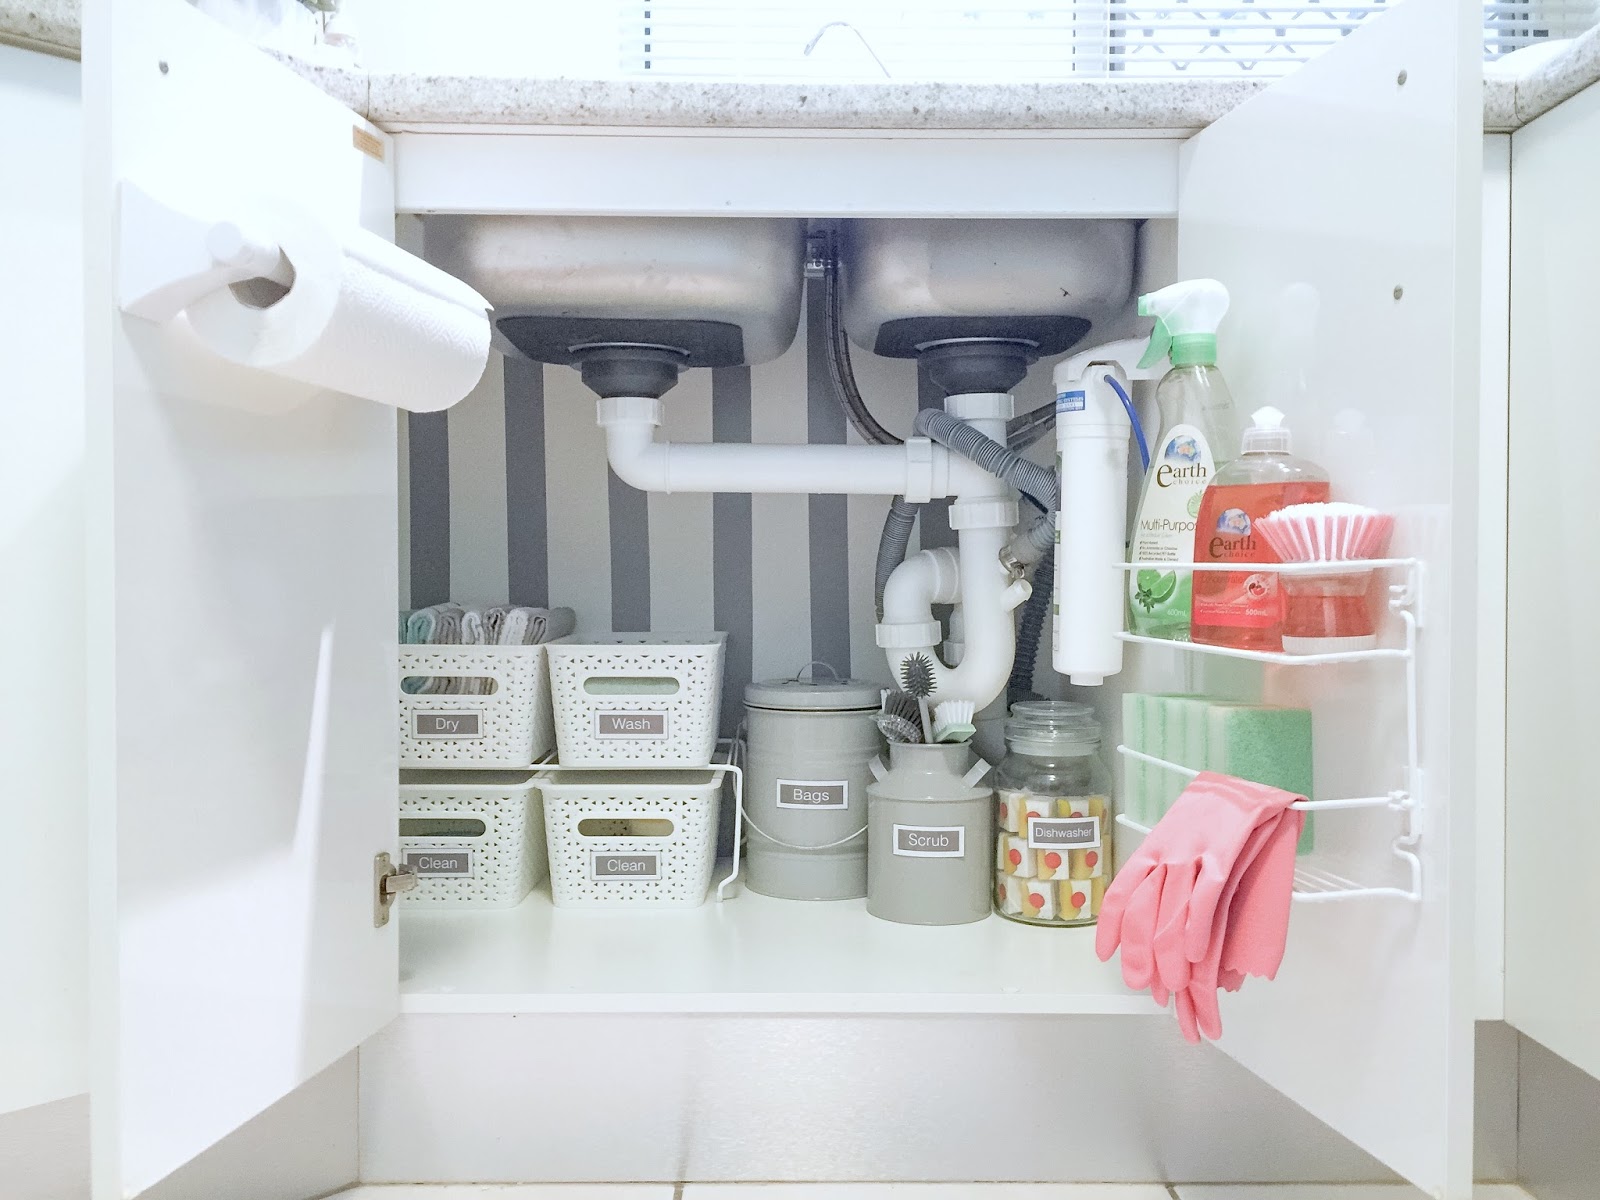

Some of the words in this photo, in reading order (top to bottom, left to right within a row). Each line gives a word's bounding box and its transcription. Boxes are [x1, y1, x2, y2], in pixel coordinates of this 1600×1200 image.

[1156, 462, 1207, 488] earth
[1141, 518, 1196, 533] Multi-Purpo
[1208, 535, 1256, 559] earth
[435, 717, 459, 731] Dry
[612, 717, 651, 730] Wash
[793, 788, 830, 804] Bags
[1034, 826, 1093, 839] Dishwasher
[908, 833, 949, 847] Scrub
[419, 857, 458, 870] Clean
[607, 859, 647, 872] Clean
